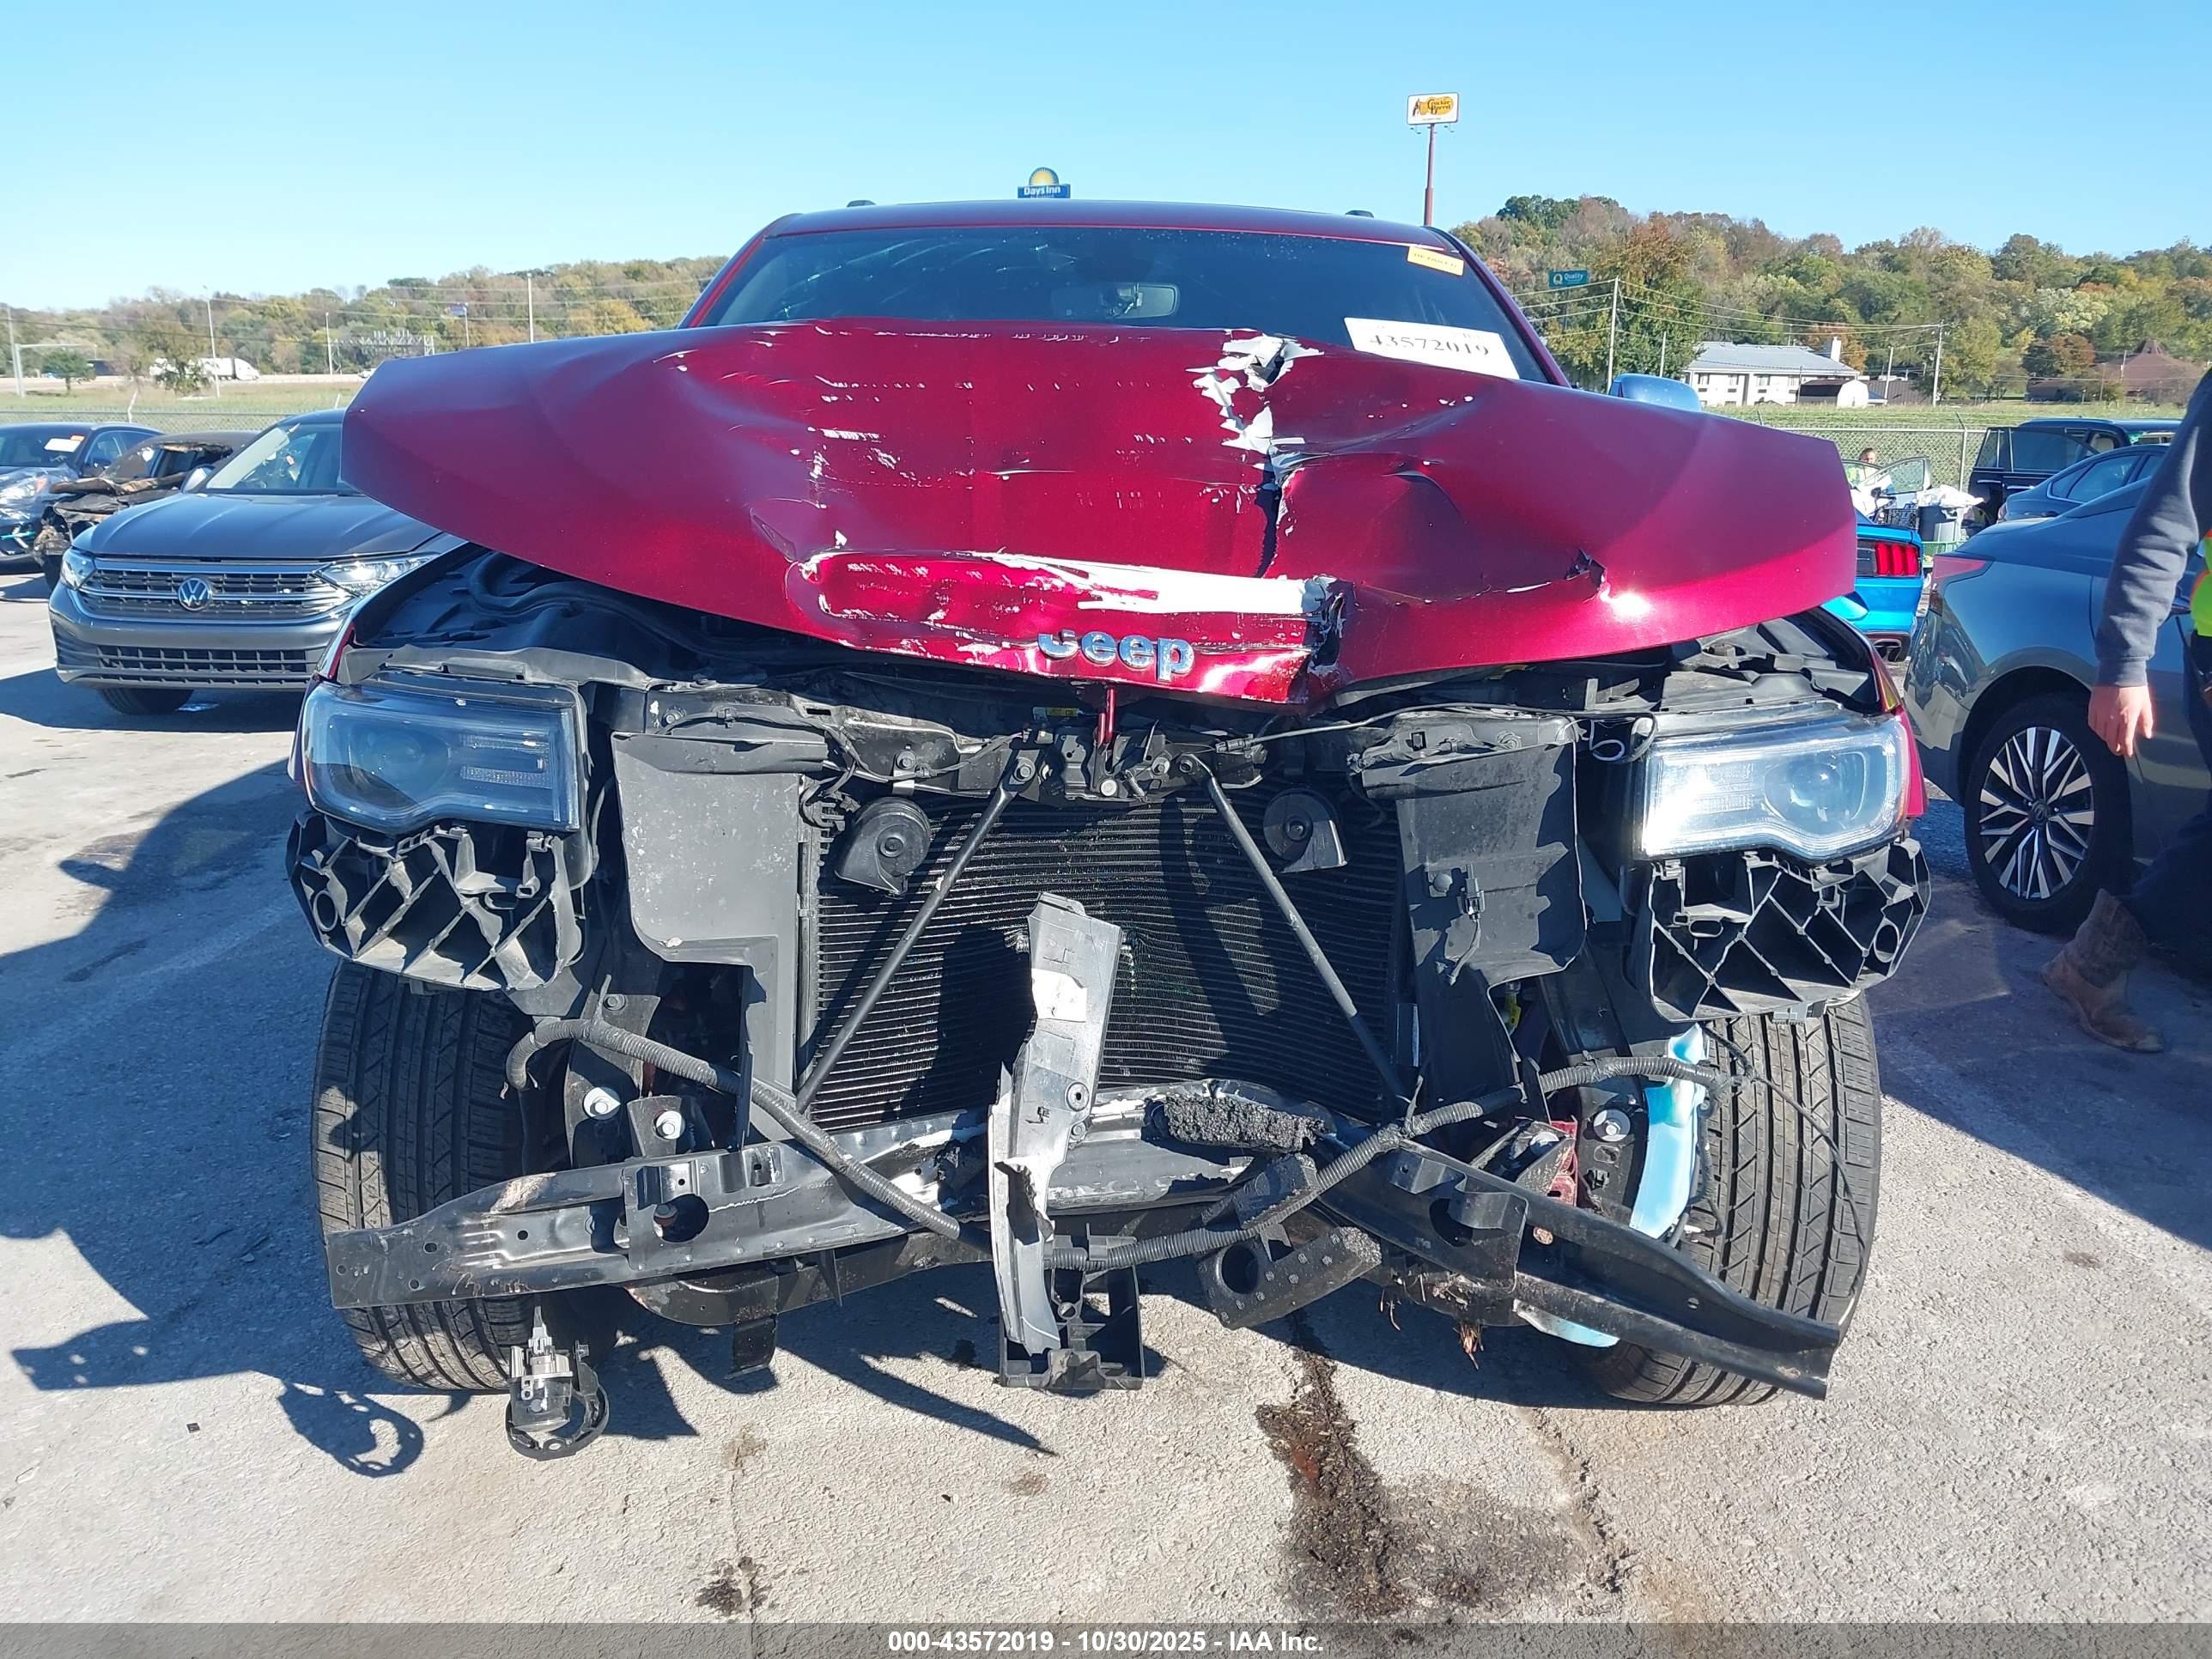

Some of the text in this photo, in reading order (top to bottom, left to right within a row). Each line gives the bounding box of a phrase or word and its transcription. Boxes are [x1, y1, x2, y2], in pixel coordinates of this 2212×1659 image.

[1024, 186, 1045, 195] Days
[1564, 272, 1583, 282] Quality
[1369, 334, 1489, 356] 43572019
[1037, 629, 1195, 683] Jeep
